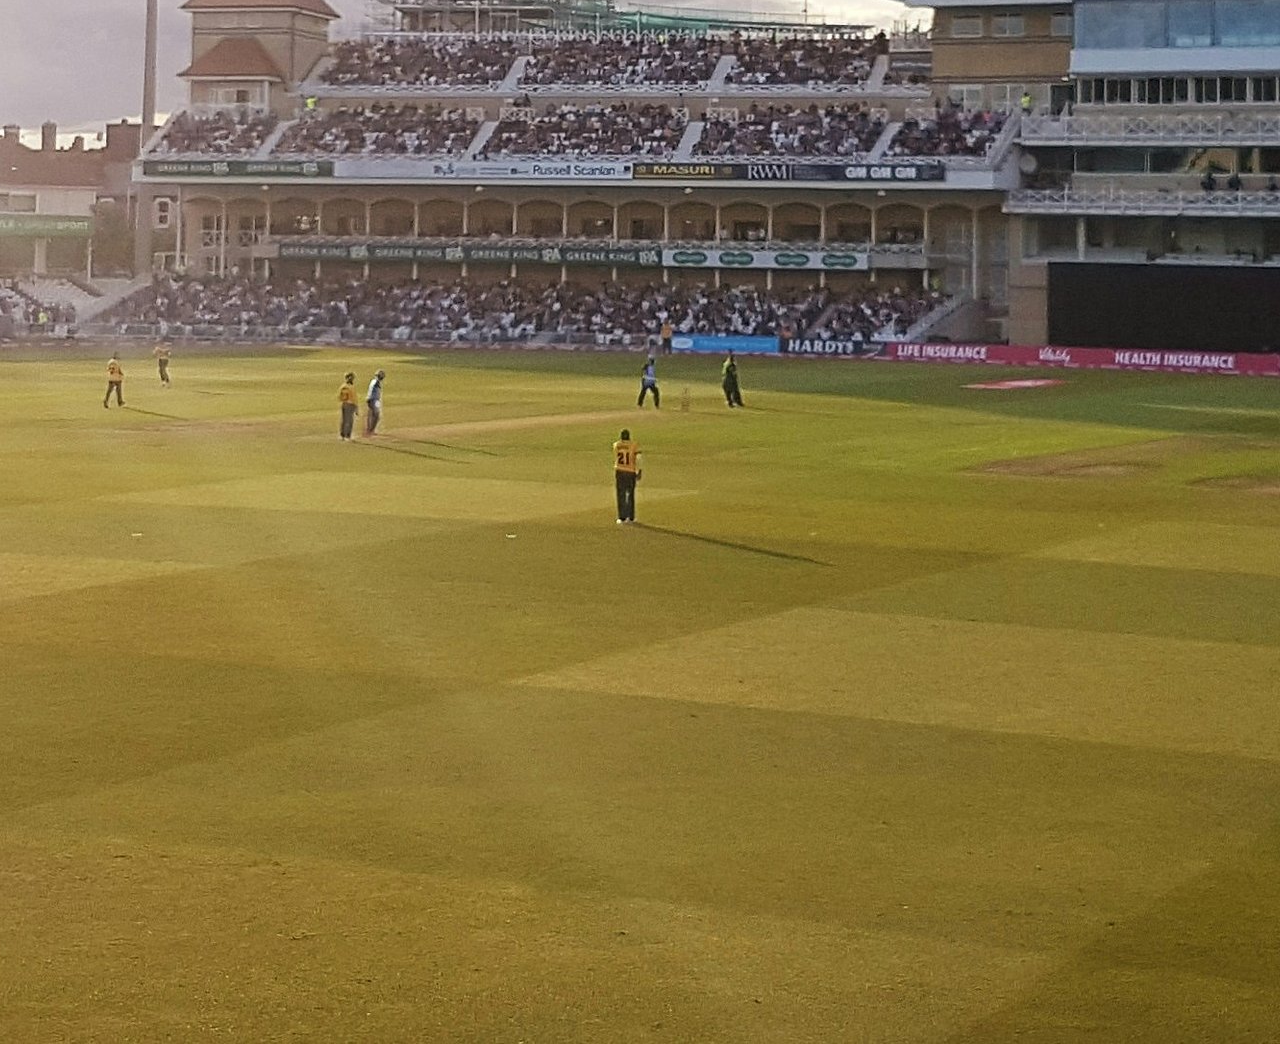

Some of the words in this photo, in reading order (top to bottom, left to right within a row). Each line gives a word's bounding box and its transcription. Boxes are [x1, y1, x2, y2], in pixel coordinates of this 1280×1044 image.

[532, 165, 571, 176] Russell
[573, 165, 616, 176] Scanlan
[653, 165, 715, 175] MASURI
[747, 164, 789, 180] RWM
[566, 251, 606, 262] GREENE
[609, 252, 636, 262] KING
[638, 250, 659, 266] IPA
[788, 338, 854, 354] HARDYS
[897, 344, 920, 357] LIFE
[922, 345, 988, 360] INSURANCE
[1114, 352, 1162, 365] HEALTH
[1163, 353, 1236, 370] INSURANCE
[617, 451, 630, 465] 21
